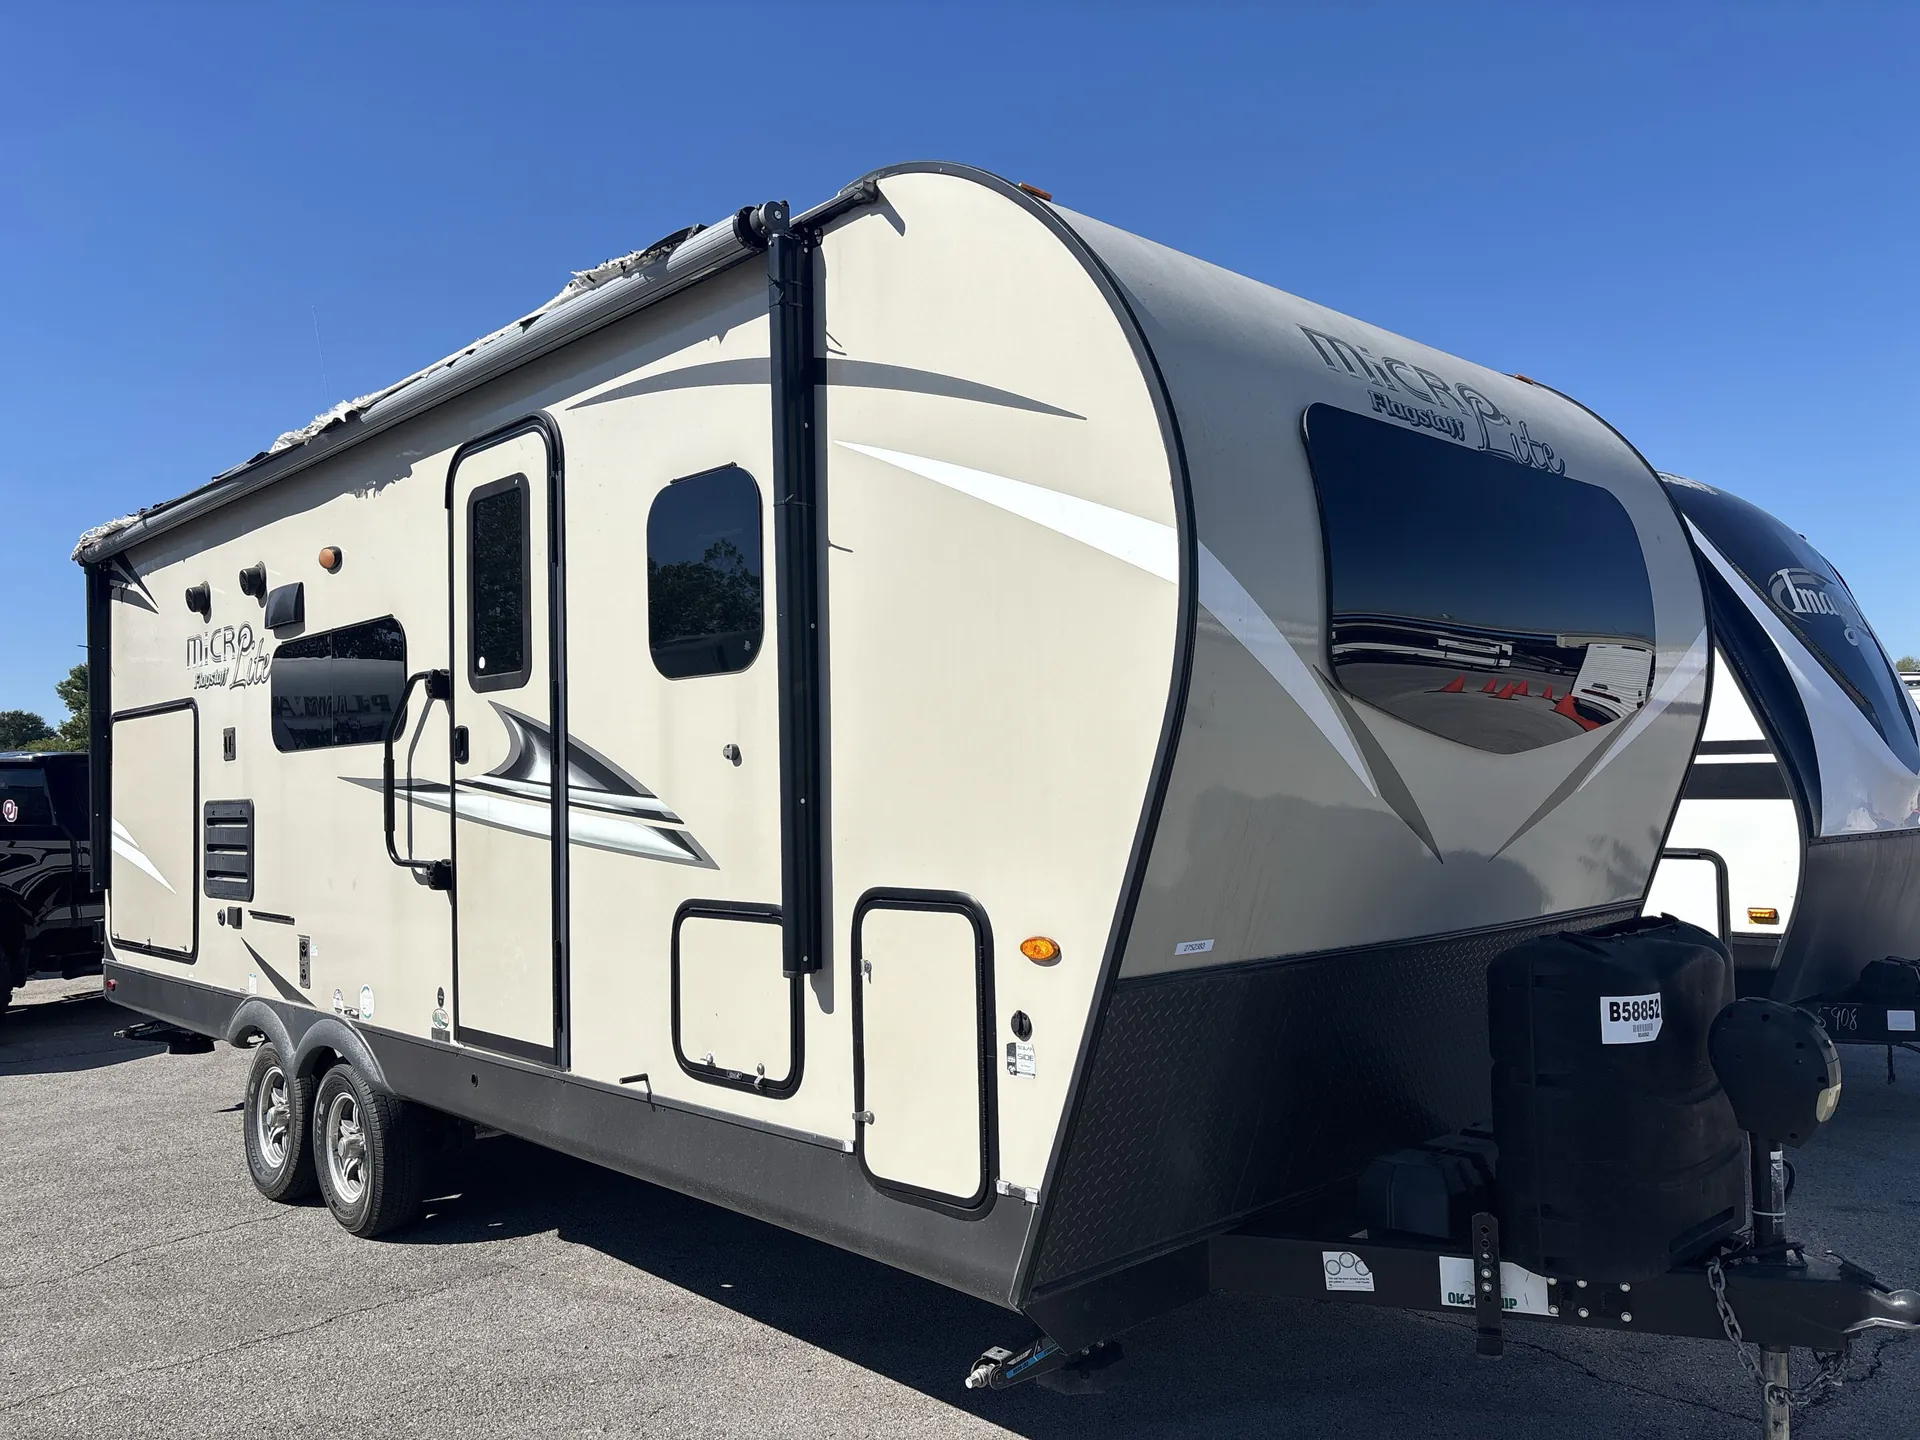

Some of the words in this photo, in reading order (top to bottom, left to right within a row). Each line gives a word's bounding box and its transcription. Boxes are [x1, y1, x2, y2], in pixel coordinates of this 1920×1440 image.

[1367, 389, 1466, 442] Flagstaff
[1467, 395, 1565, 476] Lite
[229, 634, 272, 690] Lite
[1609, 998, 1660, 1022] B58852
